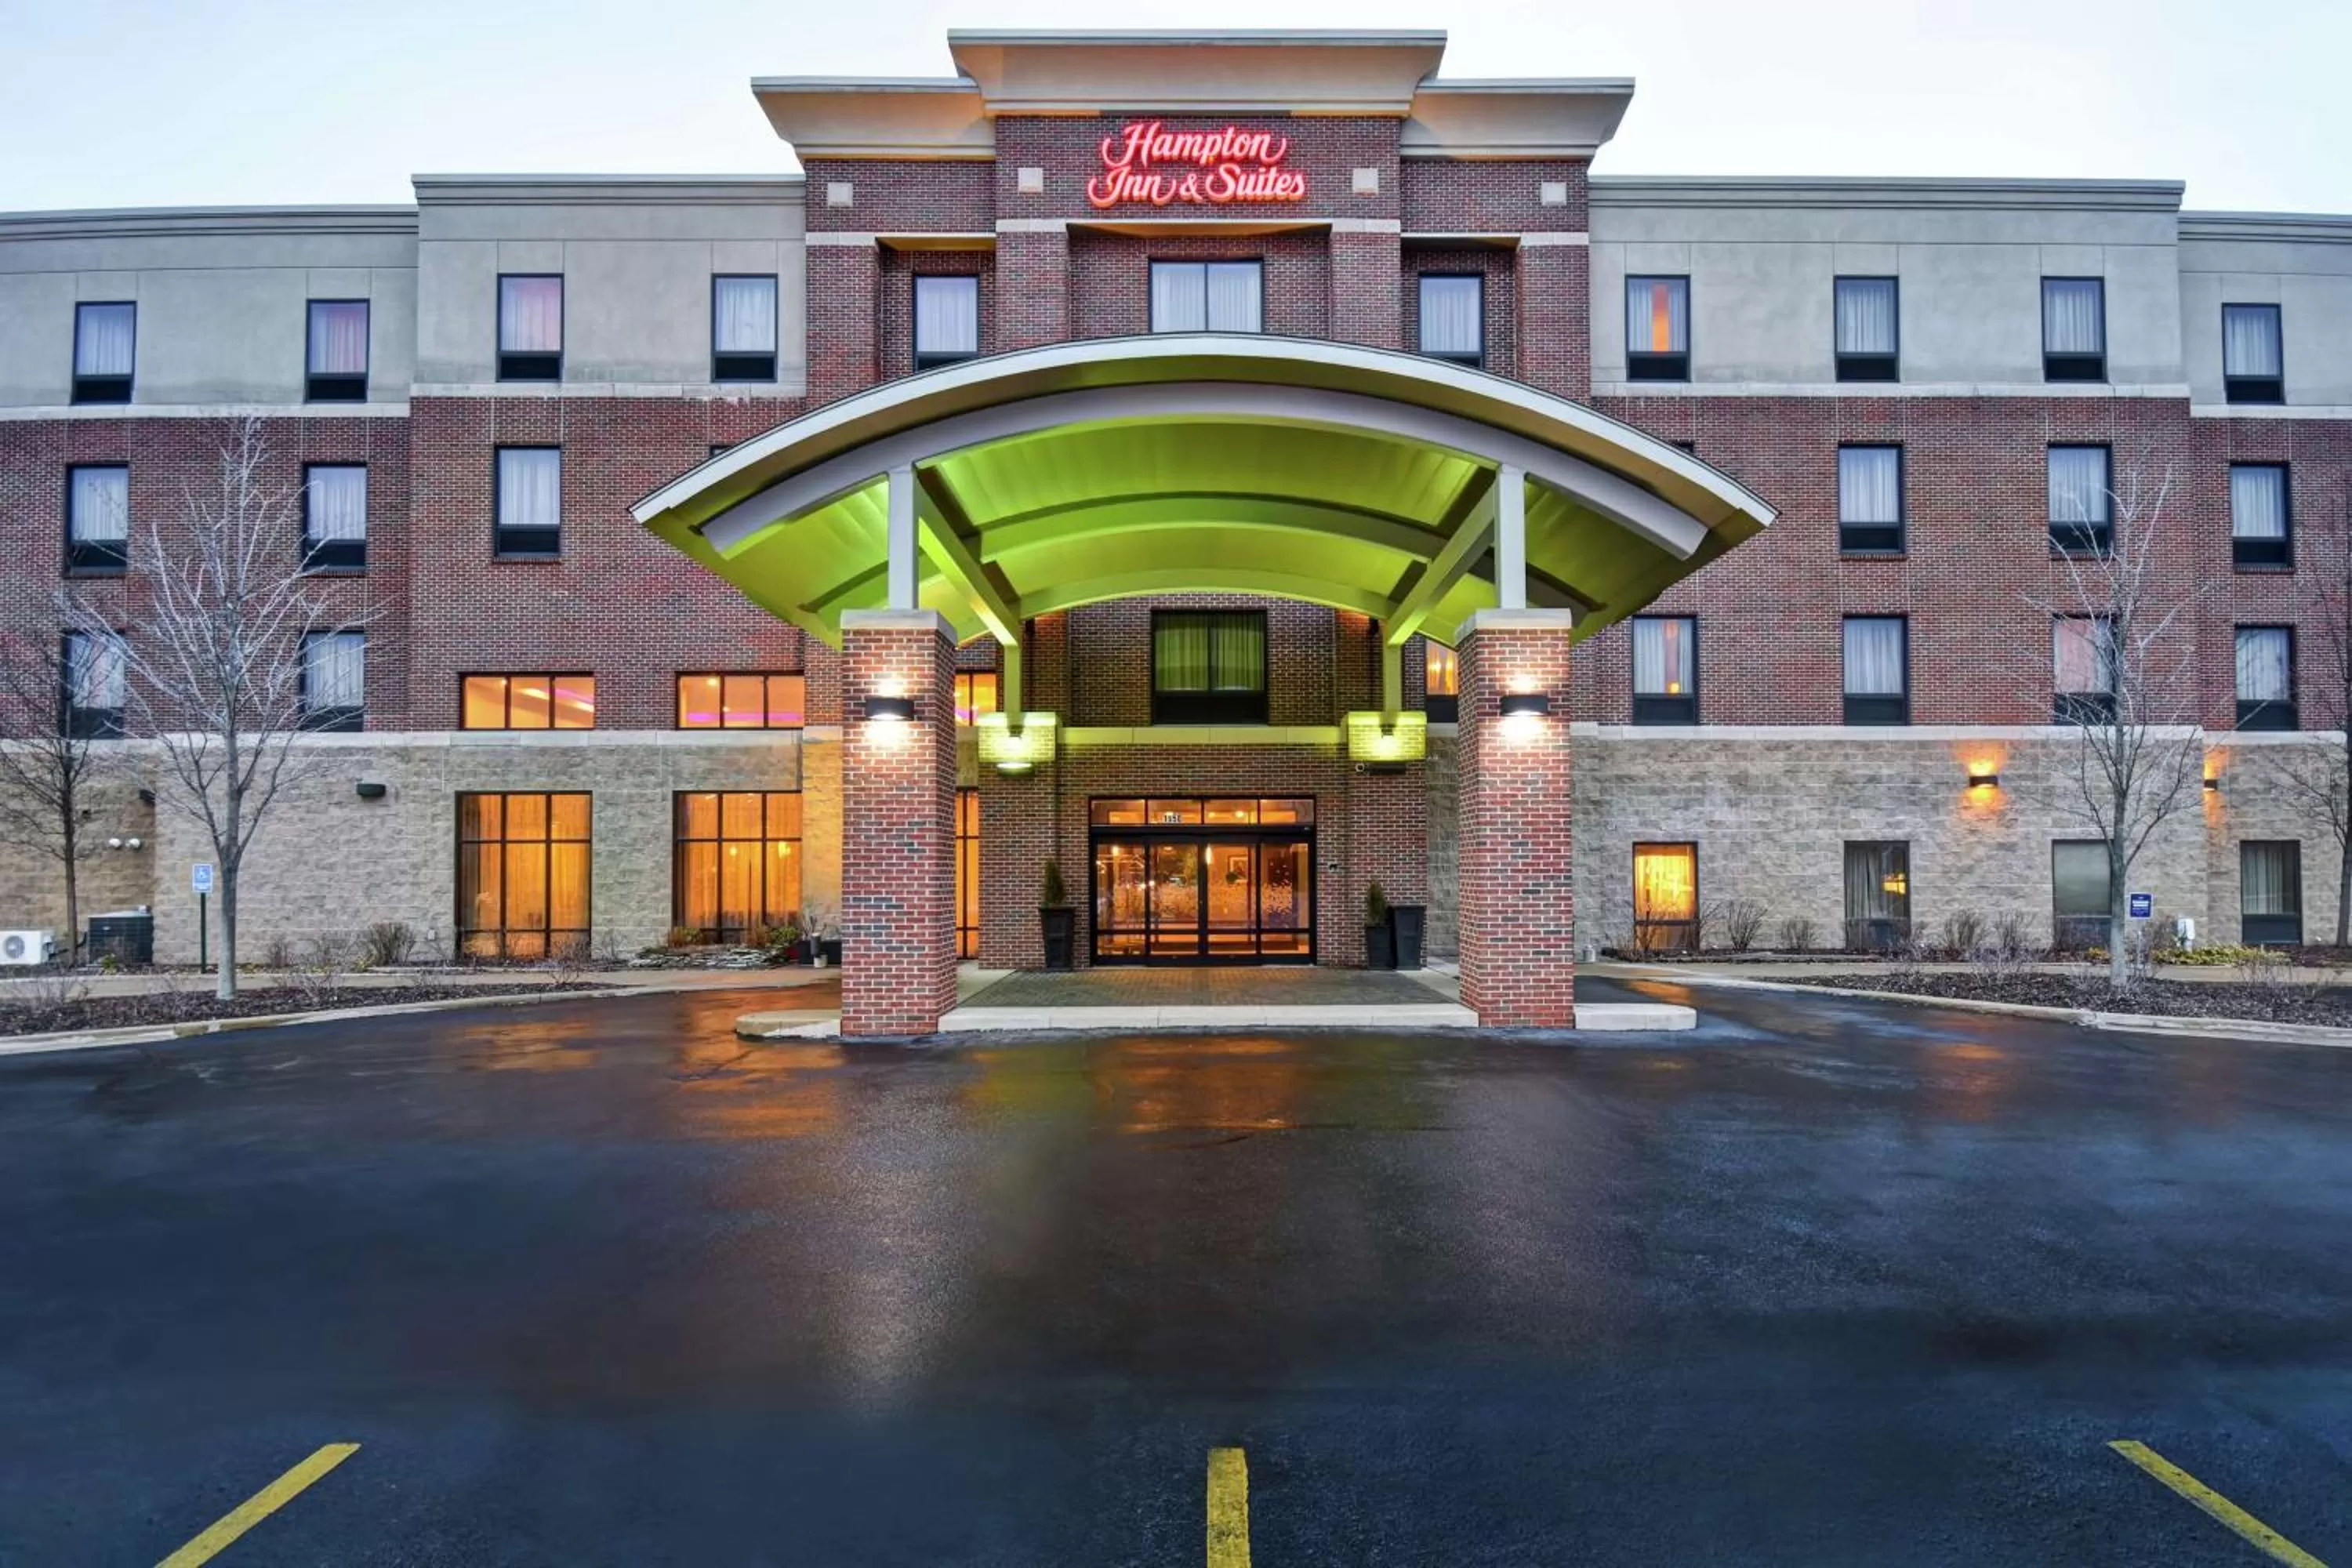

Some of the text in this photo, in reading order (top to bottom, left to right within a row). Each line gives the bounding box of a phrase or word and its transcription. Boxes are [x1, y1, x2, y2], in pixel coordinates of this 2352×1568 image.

[1102, 121, 1287, 169] Hampton
[1087, 162, 1305, 208] Inn & Suites
